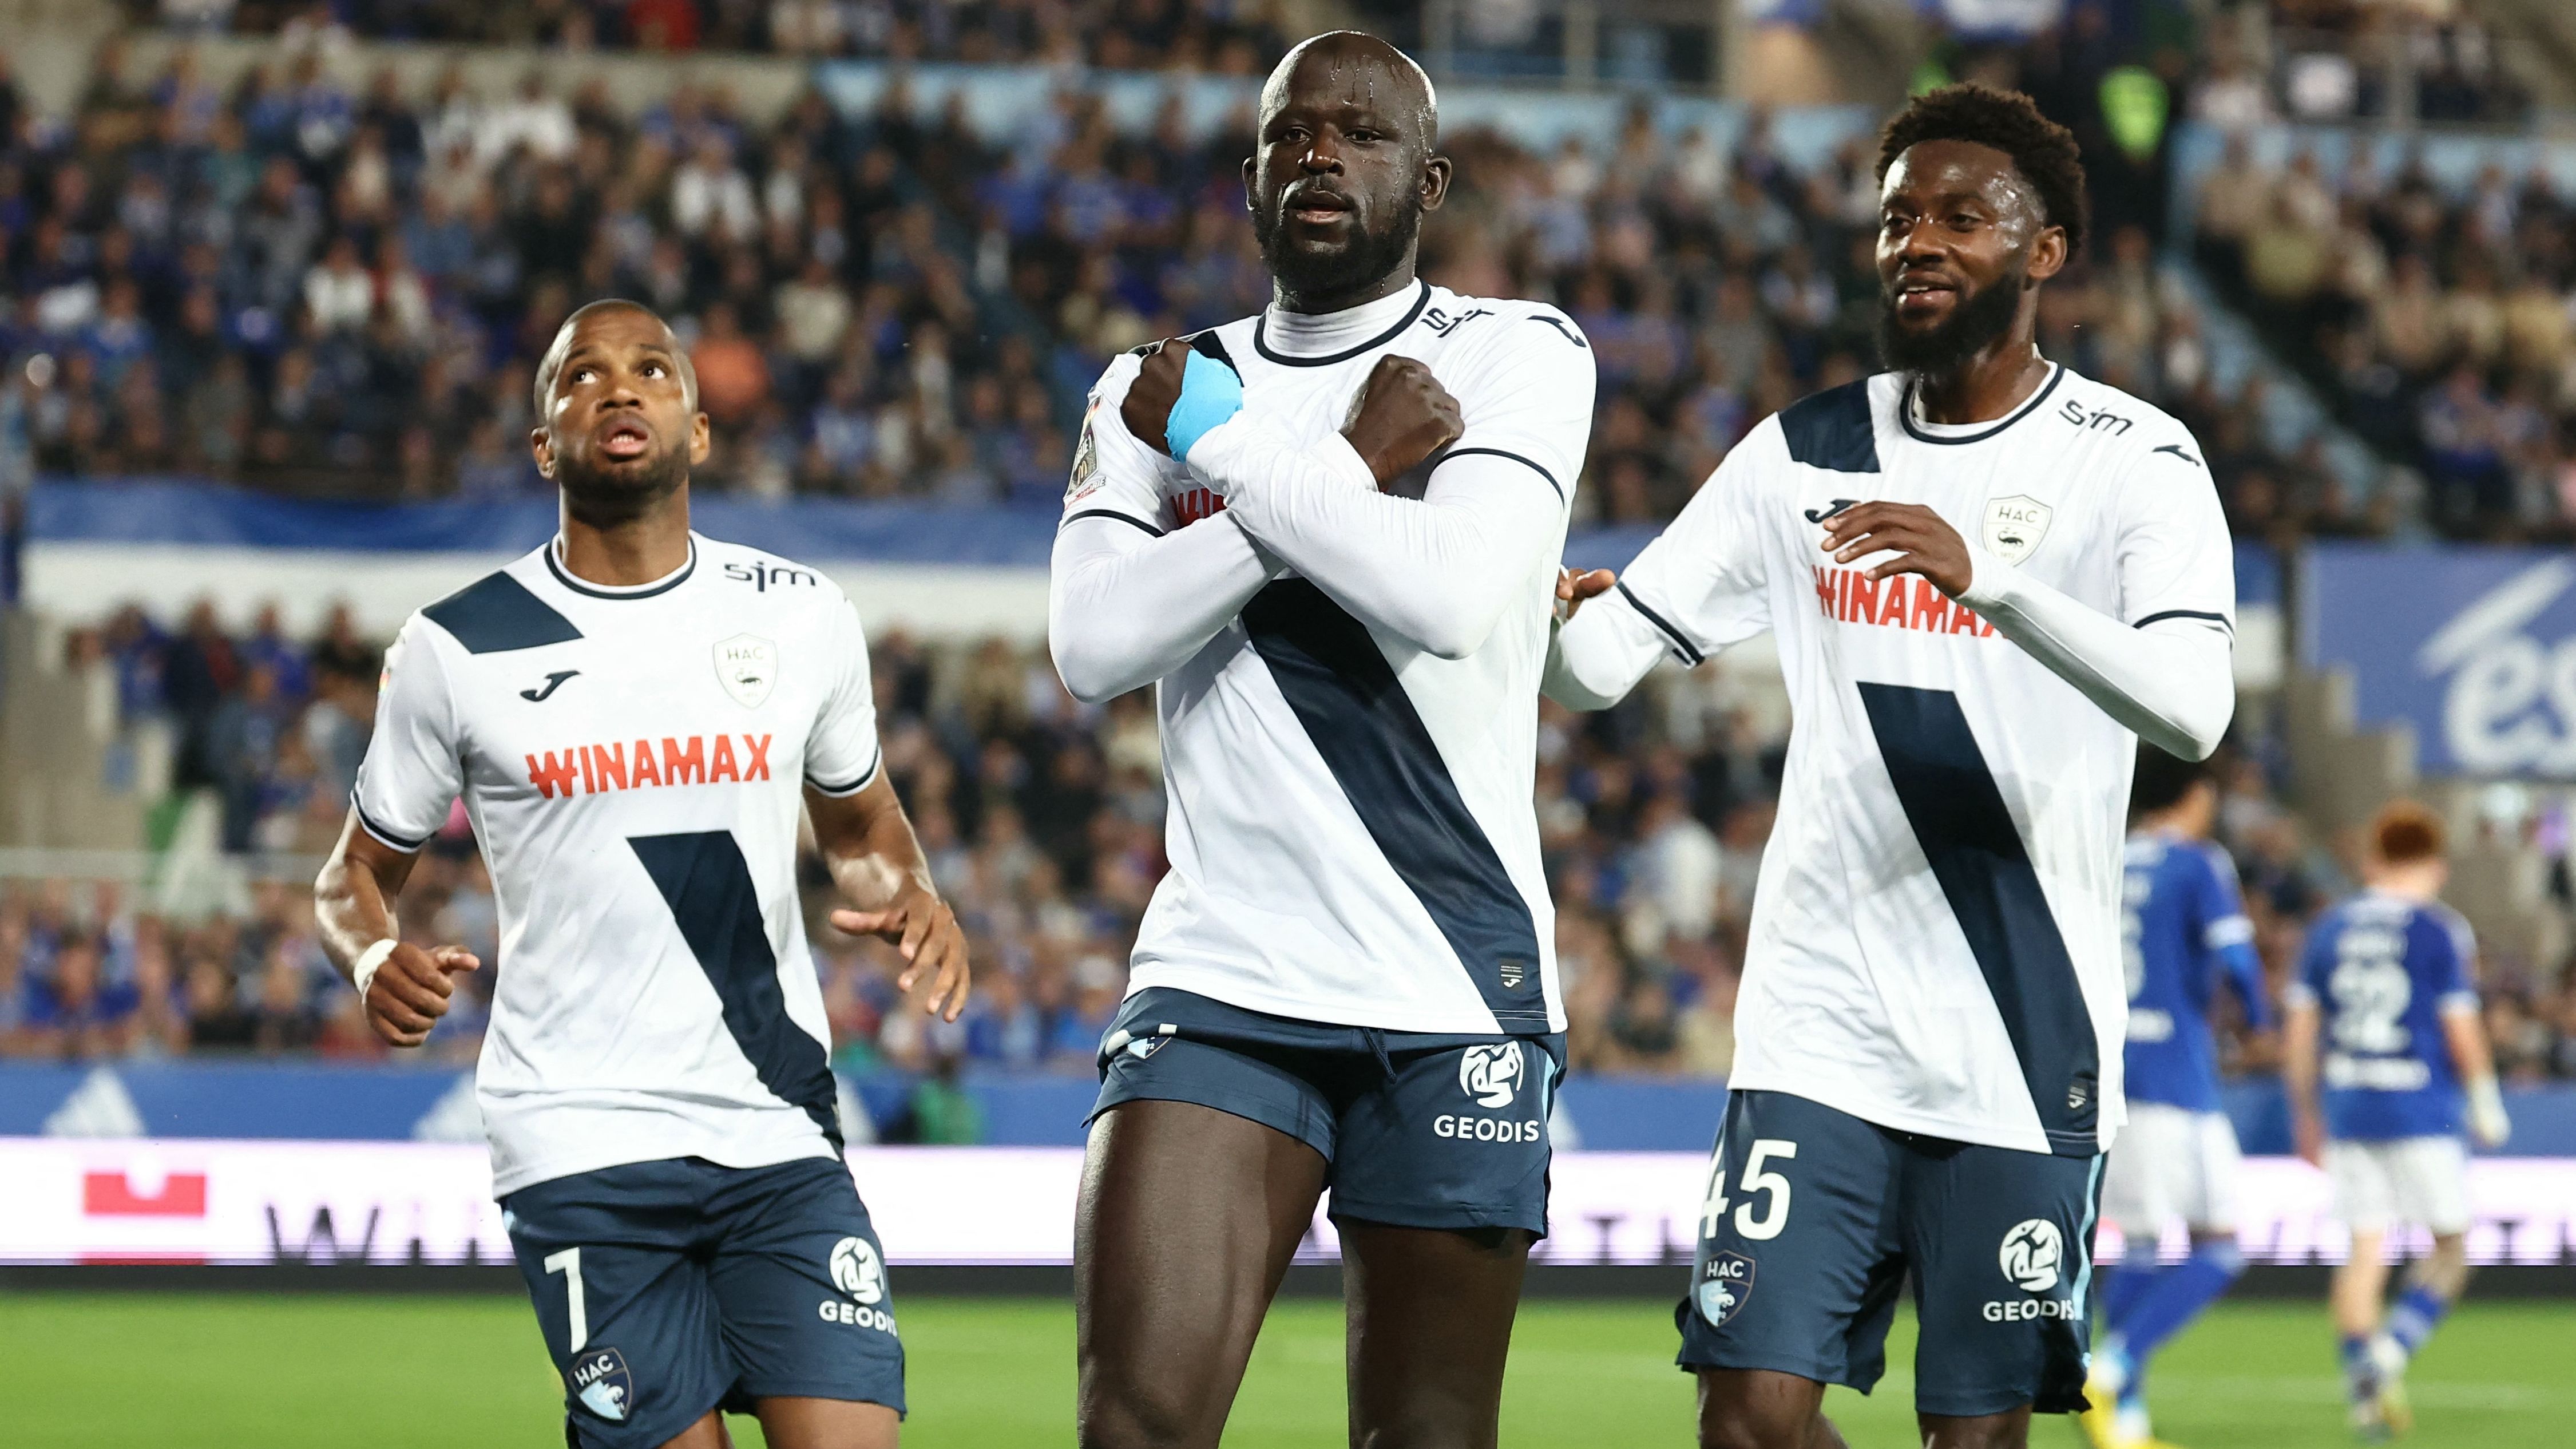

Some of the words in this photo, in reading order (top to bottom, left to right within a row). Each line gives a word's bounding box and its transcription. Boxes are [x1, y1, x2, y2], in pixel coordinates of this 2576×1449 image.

[1998, 506, 2038, 522] HAC
[1812, 564, 2007, 639] WINAMA
[727, 647, 764, 660] HAC
[525, 734, 771, 799] WINAMAX
[1434, 1115, 1539, 1142] GEODIS
[1701, 1138, 1797, 1241] 45
[1707, 1260, 1744, 1278] HAC
[574, 1355, 613, 1387] HAC
